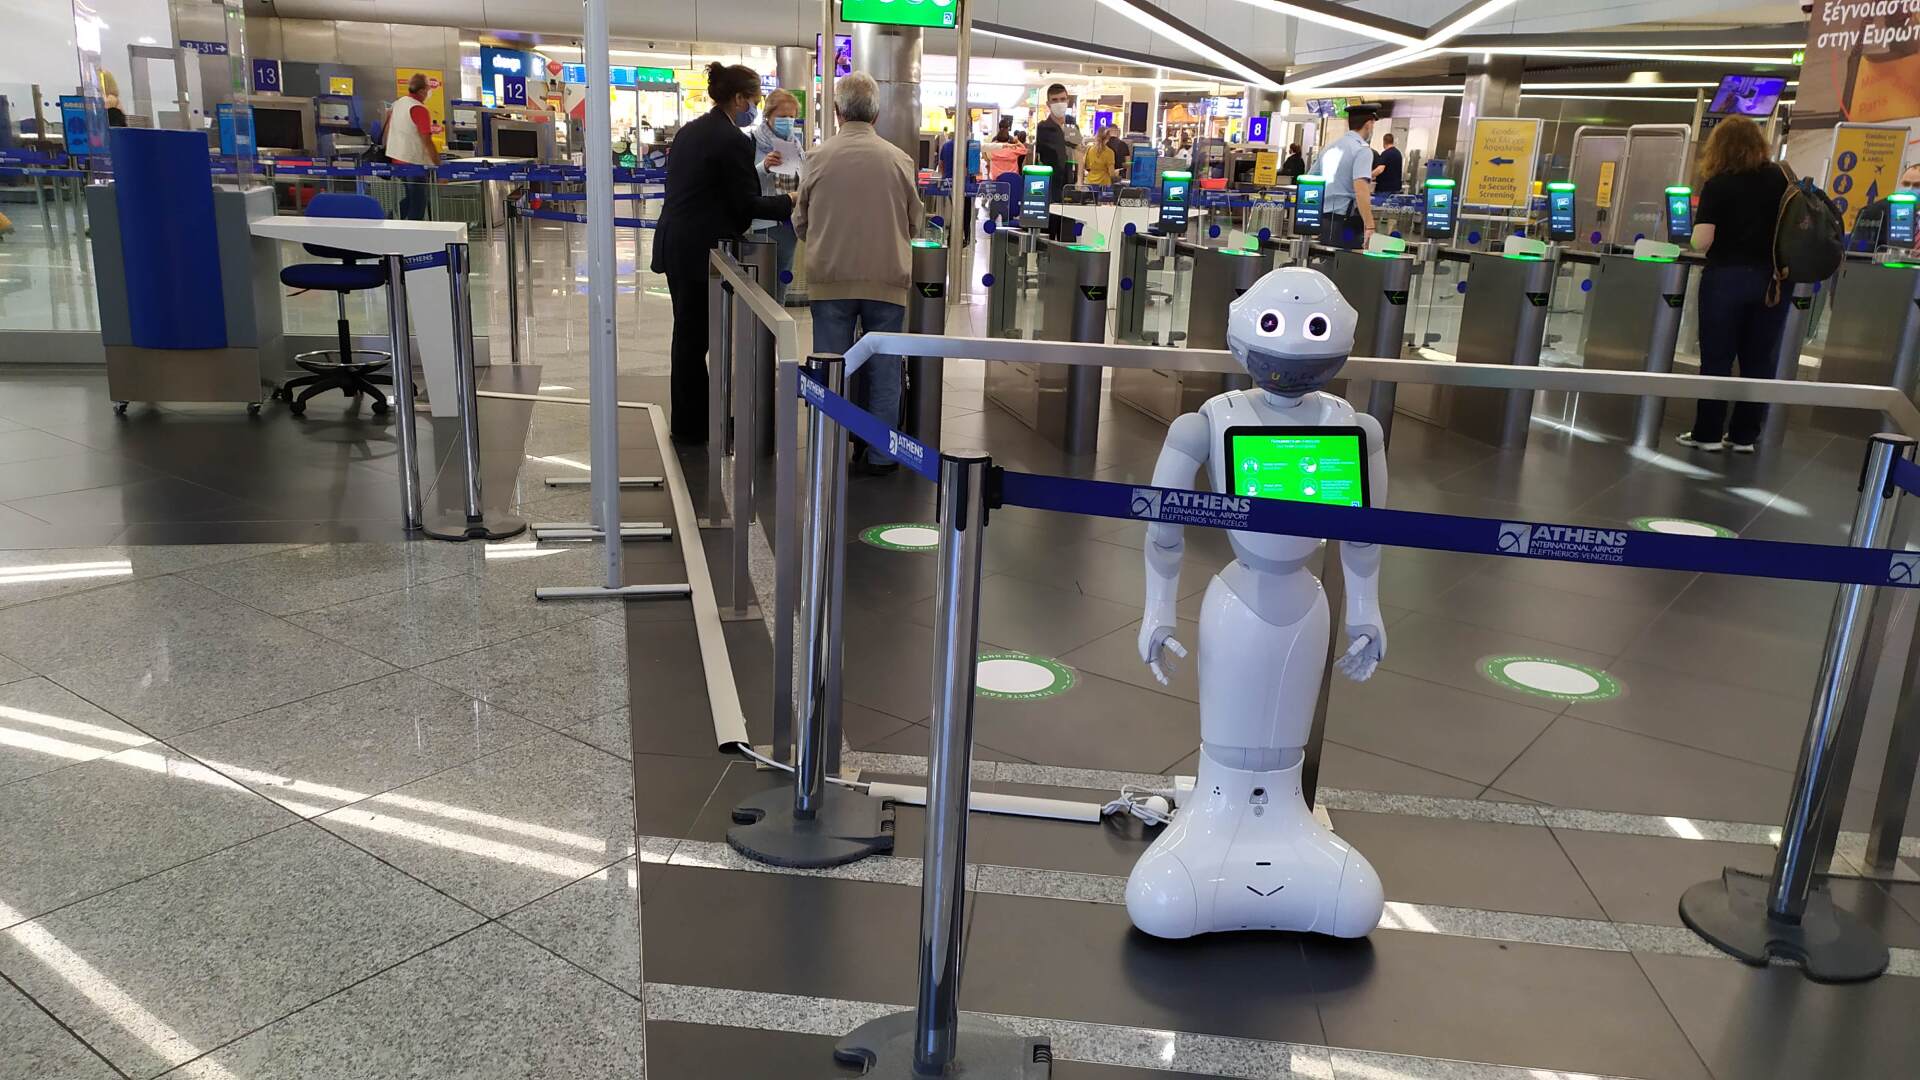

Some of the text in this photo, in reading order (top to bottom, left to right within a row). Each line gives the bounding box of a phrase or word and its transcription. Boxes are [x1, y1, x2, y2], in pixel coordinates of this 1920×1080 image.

[1817, 30, 1860, 51] στην
[257, 67, 277, 85] 13
[506, 83, 524, 99] 12
[1253, 122, 1262, 136] 8
[1480, 191, 1514, 199] Screening
[1487, 184, 1517, 192] Security
[807, 379, 825, 398] ATHENS
[898, 434, 924, 459] ATHENS
[1163, 492, 1251, 513] ATHENS
[1161, 505, 1249, 521] INTERNATIONAL AIRPORT
[1161, 513, 1249, 528] ELEFTHERIOS VENIZELOS
[1532, 525, 1628, 547] ATHENS
[1529, 547, 1624, 562] ELEFTHERIOS VENIZELOS
[1531, 540, 1625, 555] INTERNATIONAL AIRPORT
